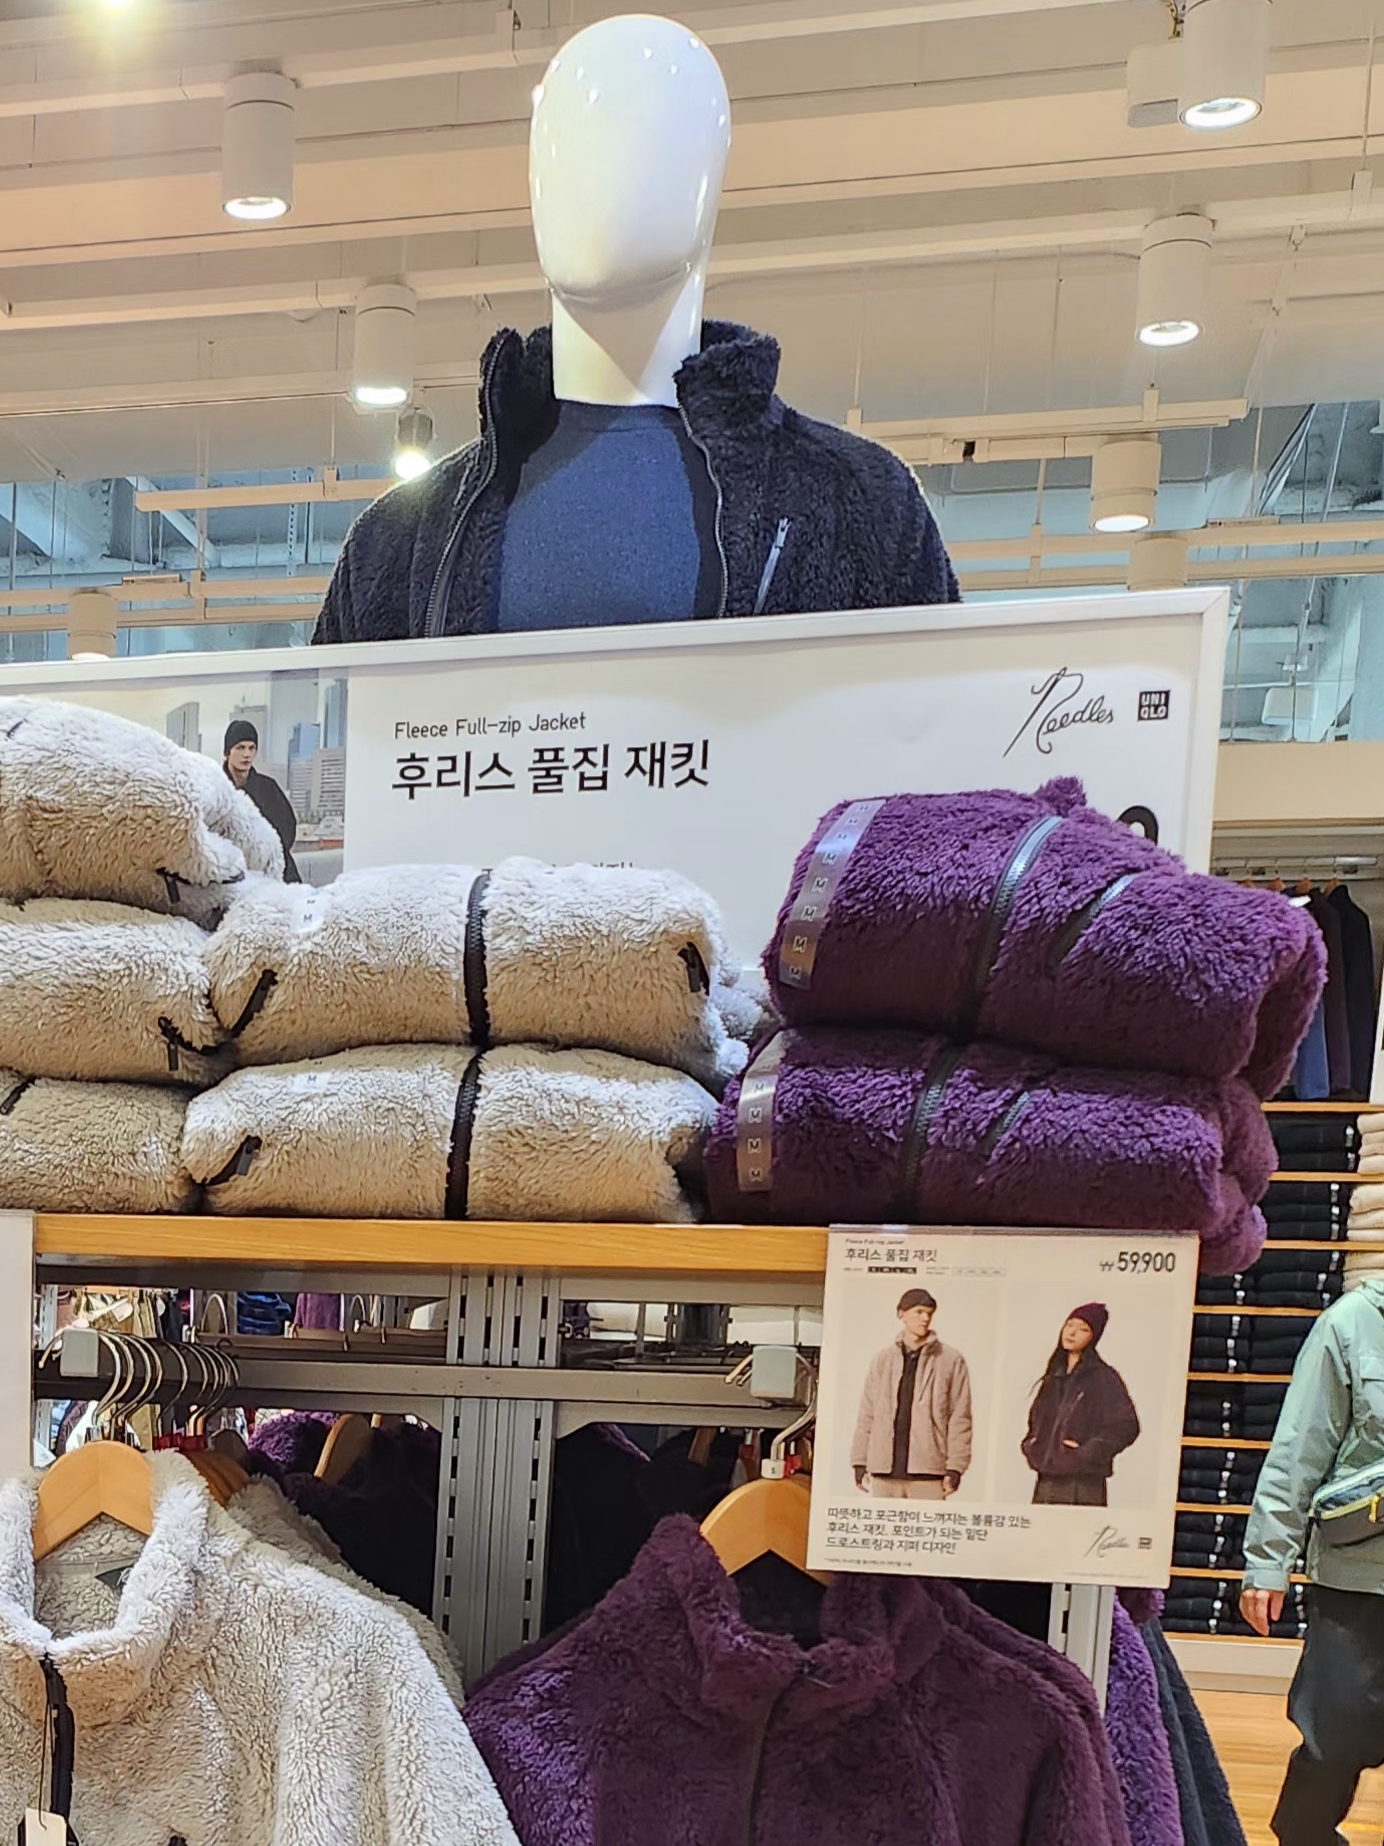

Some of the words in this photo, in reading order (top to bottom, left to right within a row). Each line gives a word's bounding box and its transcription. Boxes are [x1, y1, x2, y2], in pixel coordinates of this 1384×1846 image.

[394, 720, 448, 740] Fleece
[455, 716, 522, 738] Full-zip
[528, 711, 587, 733] Jacket
[392, 750, 516, 800] 후리스
[527, 743, 611, 794] 풀집
[624, 738, 710, 789] 재킷
[815, 878, 826, 891] M
[303, 914, 313, 922] M
[804, 907, 816, 920] M
[794, 937, 806, 950] M
[844, 1247, 882, 1262] 후리스
[885, 1248, 909, 1262] 풀집
[912, 1249, 938, 1263] 재킷
[828, 1507, 873, 1521] 따뜻하고
[875, 1509, 920, 1523] 포근함이
[922, 1511, 968, 1526] 느껴지는
[1008, 1515, 1031, 1529] 있는
[826, 1521, 860, 1534] 후리스
[891, 1525, 937, 1539] 포인트가
[939, 1527, 963, 1540] 되는
[897, 1540, 920, 1553] 지퍼
[922, 1541, 956, 1555] 디자인
